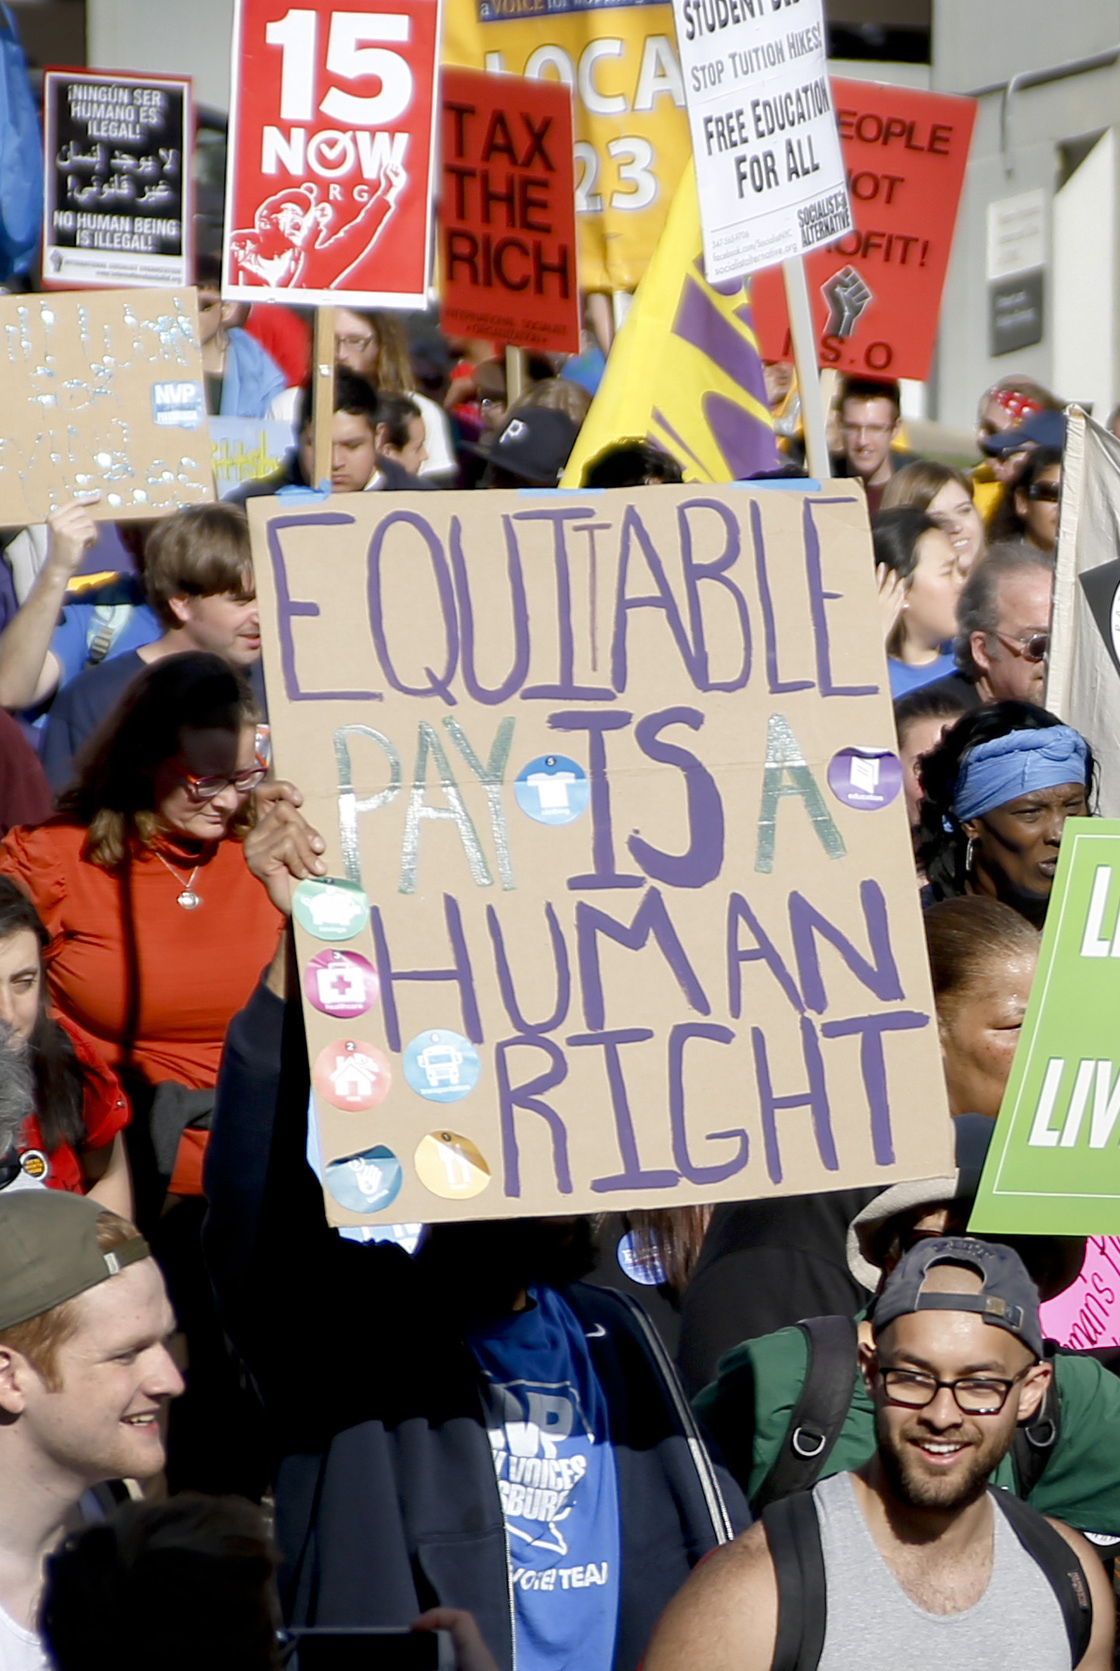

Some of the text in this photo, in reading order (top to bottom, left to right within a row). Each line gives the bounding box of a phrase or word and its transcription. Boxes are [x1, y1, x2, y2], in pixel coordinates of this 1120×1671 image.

[265, 8, 413, 125] 15
[691, 21, 822, 92] STOP TUITION HIKES!
[71, 101, 159, 123] HUMANO ES
[133, 88, 162, 106] SER
[703, 76, 831, 156] FREE EDUCATION
[261, 125, 409, 179] NOW
[444, 100, 556, 172] TAX
[838, 109, 953, 155] EOPLE
[443, 162, 553, 233] THE
[574, 136, 657, 213] 23
[734, 134, 820, 199] FOR ALL
[848, 168, 905, 205] OT
[53, 210, 177, 236] NO HUMAN BEING
[76, 229, 154, 250] IS ILLEGAL!
[796, 191, 844, 228] SOCIALIST
[800, 208, 851, 248] ALTERNATIVE
[446, 226, 570, 299] RICH
[826, 229, 930, 268] OFIT!
[266, 497, 880, 707] EQUITABLE
[332, 706, 847, 894] PAY IS A
[371, 879, 906, 1052] HUMAN
[496, 1012, 930, 1198] RIGHT
[508, 1454, 587, 1490] VOICES
